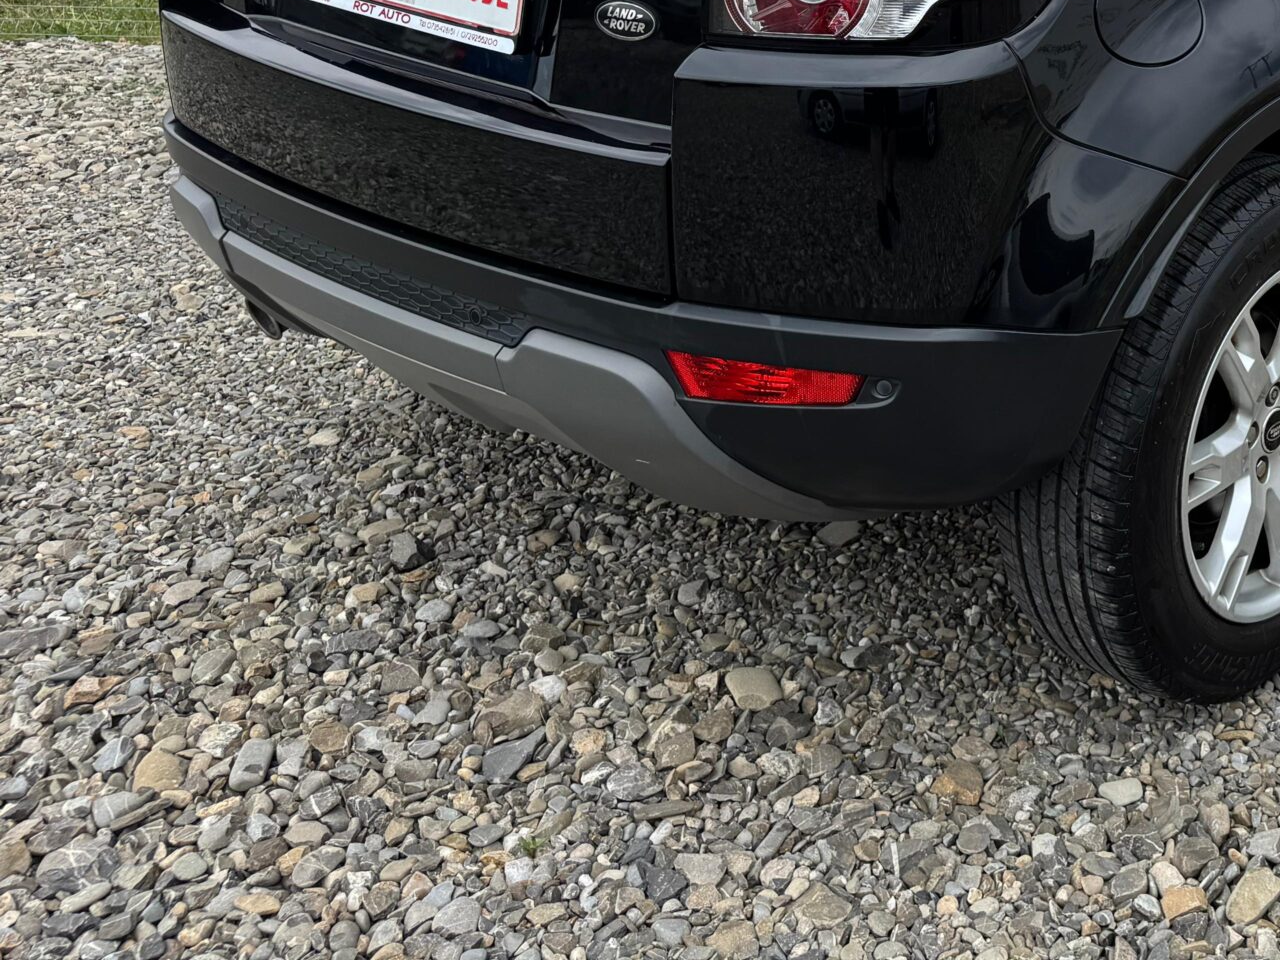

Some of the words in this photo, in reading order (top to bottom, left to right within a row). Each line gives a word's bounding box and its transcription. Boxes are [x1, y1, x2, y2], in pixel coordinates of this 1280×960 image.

[353, 0, 376, 15] ROT
[378, 8, 411, 24] AUTO
[607, 6, 636, 20] LAND
[610, 18, 646, 33] ROVER
